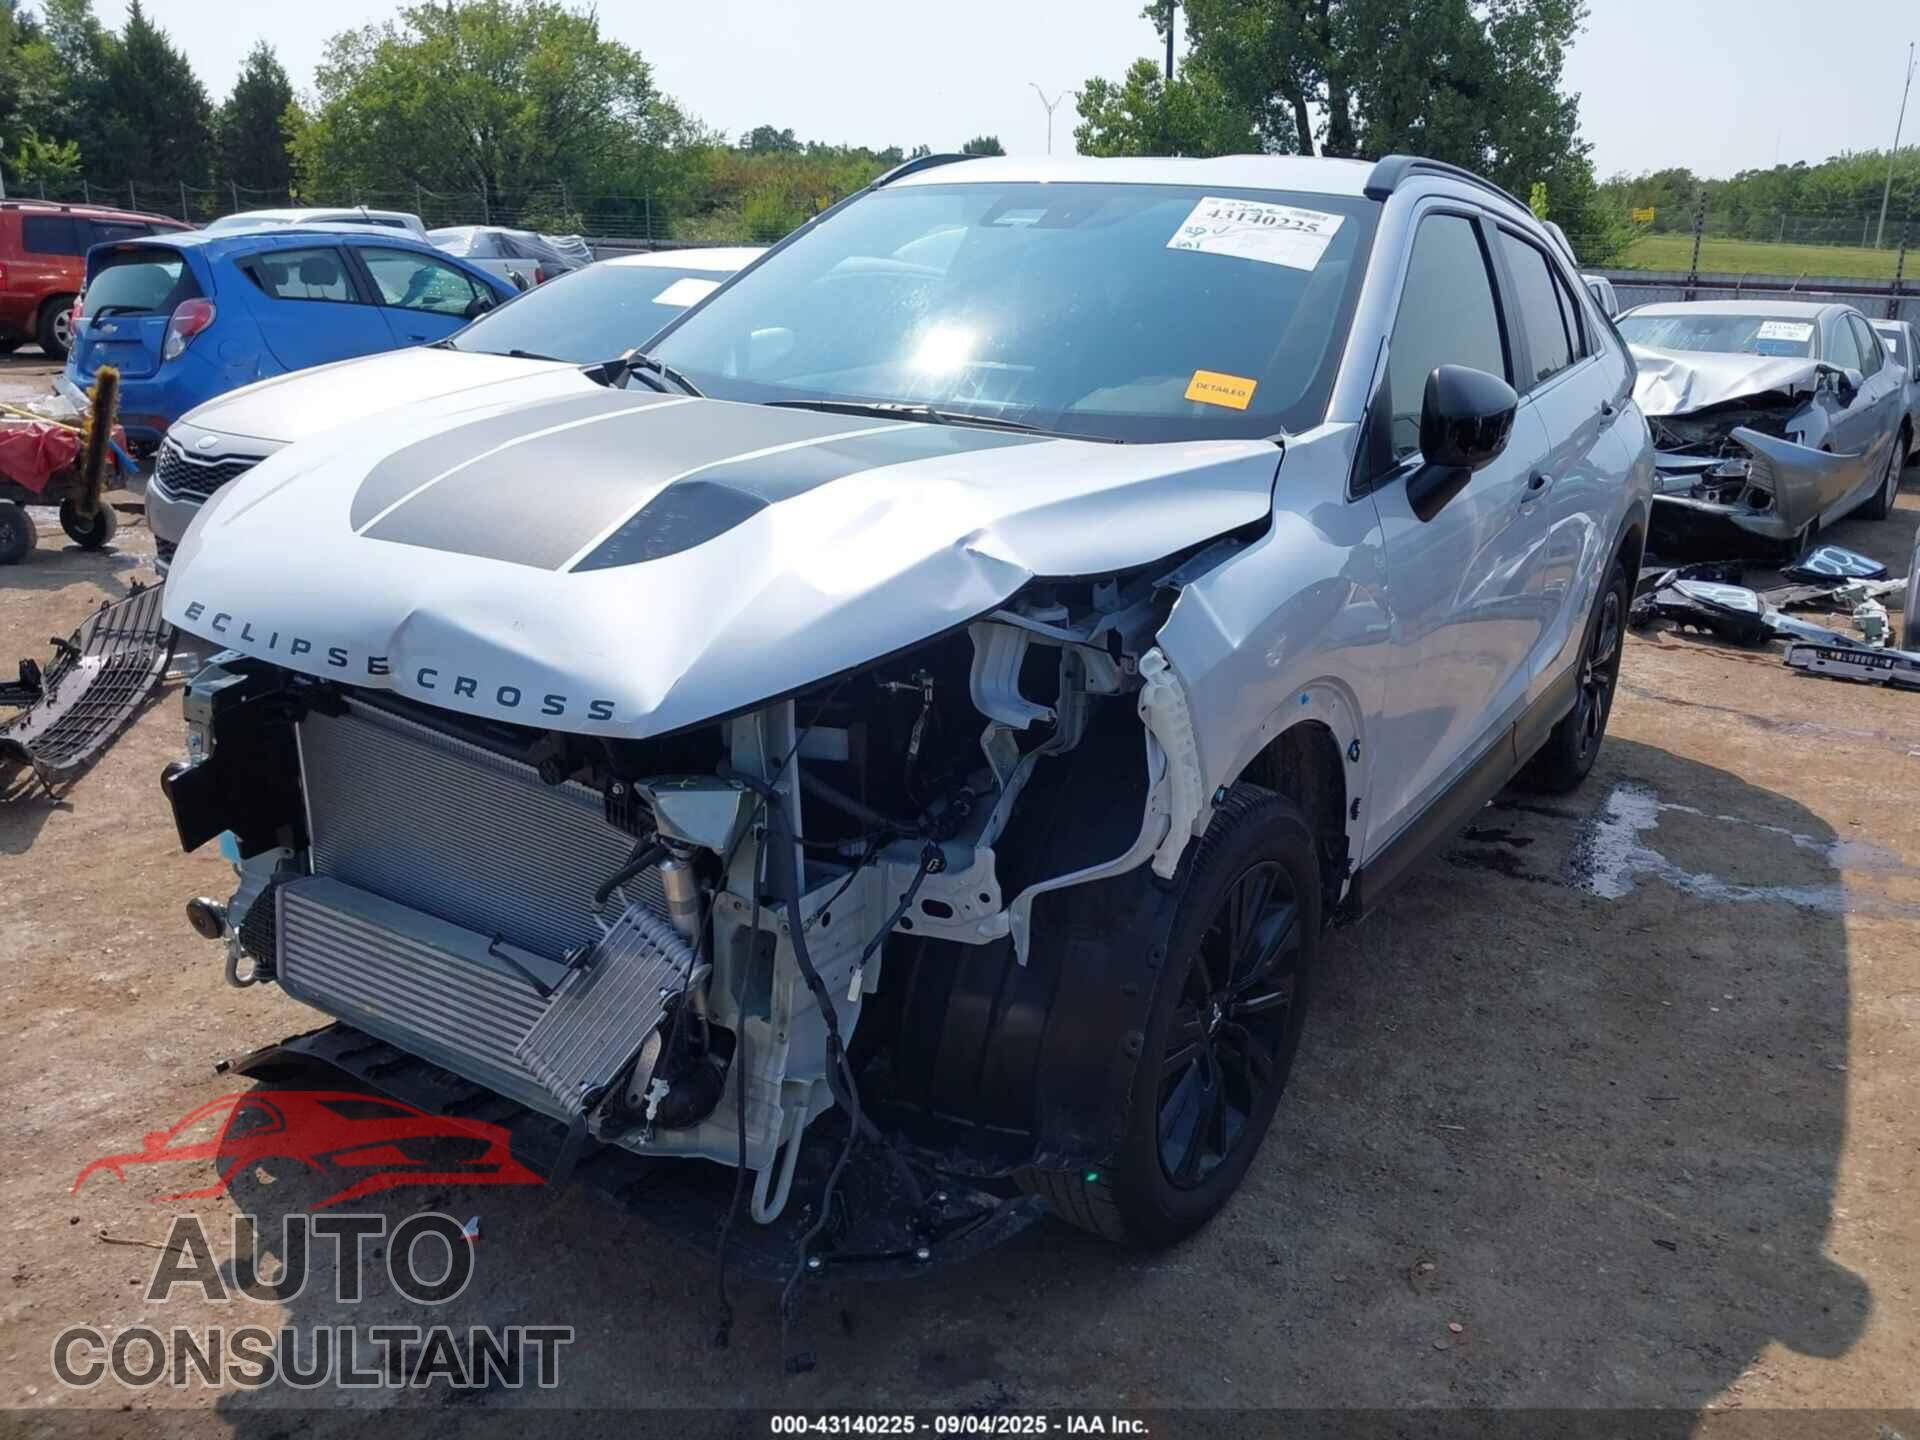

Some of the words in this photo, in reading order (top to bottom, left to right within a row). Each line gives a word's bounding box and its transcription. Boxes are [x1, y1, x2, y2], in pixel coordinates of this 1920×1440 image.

[1206, 208, 1321, 233] 43140225
[1196, 383, 1246, 397] DETAILED
[184, 600, 390, 675] ECLIPSE
[417, 667, 616, 721] CROSS
